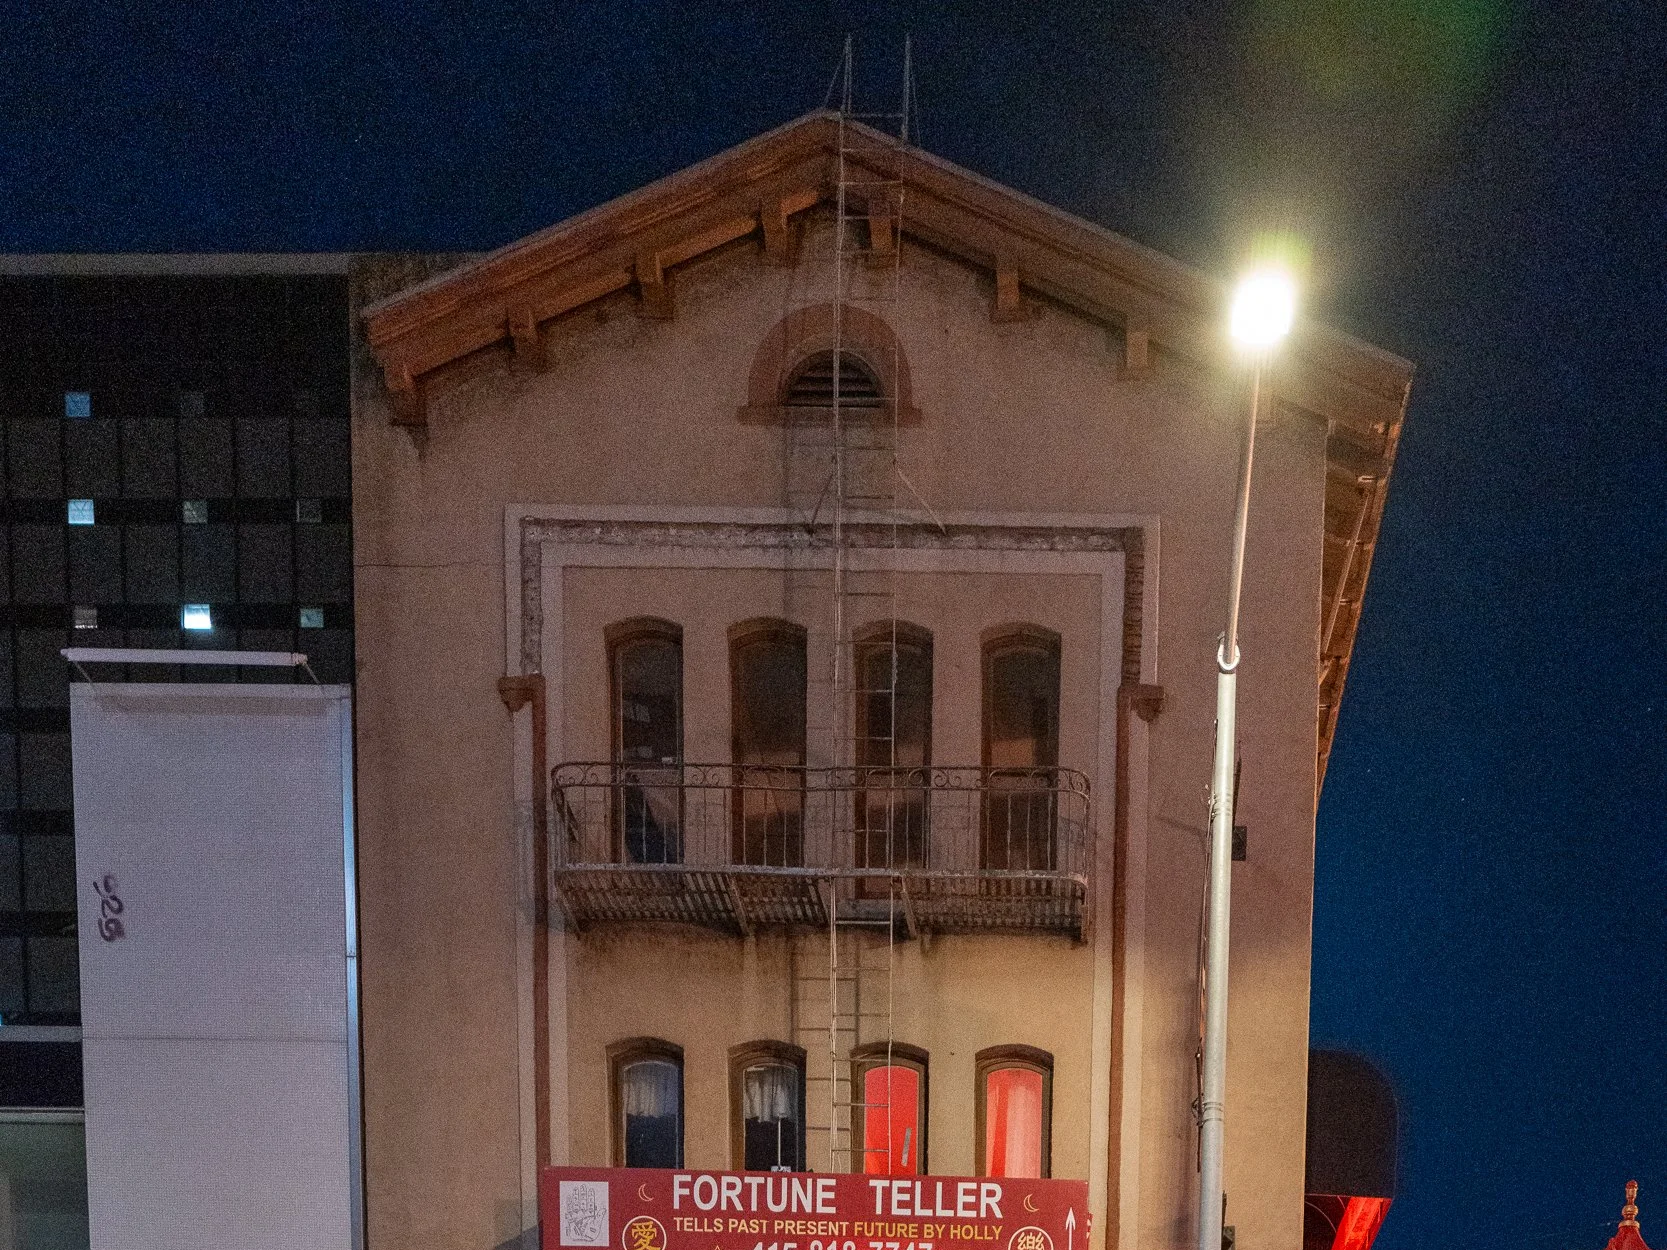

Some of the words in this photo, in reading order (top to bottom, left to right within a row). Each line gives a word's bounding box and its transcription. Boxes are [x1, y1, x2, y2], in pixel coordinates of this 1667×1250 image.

[672, 1174, 837, 1213] FORTUNE
[869, 1179, 1003, 1219] TELLER
[673, 1217, 724, 1233] TELLS
[728, 1219, 769, 1235] PAST
[776, 1220, 849, 1237] PRESENT
[854, 1223, 918, 1238] FUTURE
[923, 1224, 943, 1239] BY
[949, 1224, 1003, 1241] HOLLY
